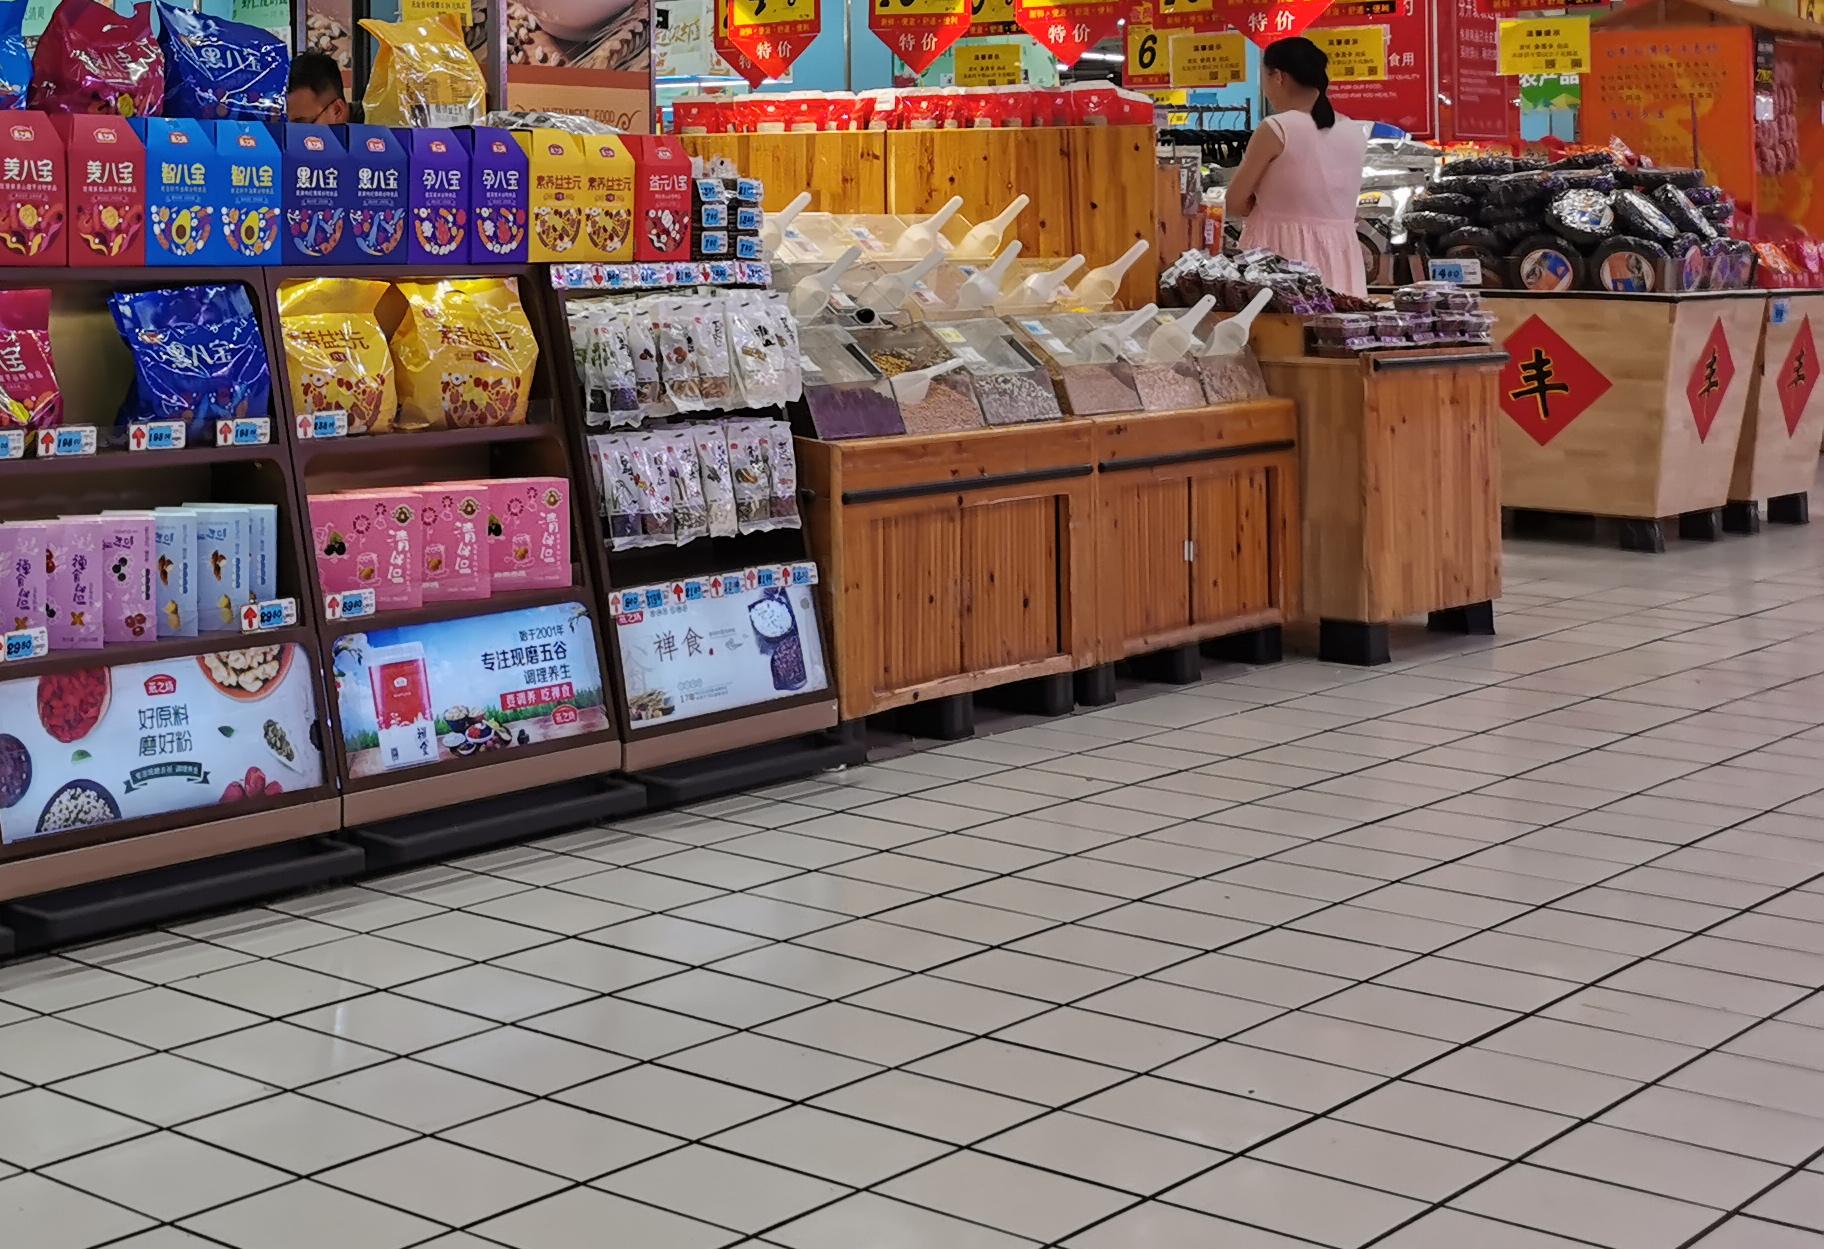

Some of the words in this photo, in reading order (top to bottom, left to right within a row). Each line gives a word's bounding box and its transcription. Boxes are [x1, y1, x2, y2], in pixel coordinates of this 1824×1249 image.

[1047, 23, 1091, 44] 特价
[1247, 11, 1295, 33] 特价
[756, 40, 792, 60] 特价
[898, 32, 938, 52] 特价
[2, 158, 54, 182] 美八宝
[86, 160, 134, 184] 美八宝
[161, 162, 207, 186] 智八宝
[231, 163, 274, 187] 智八宝
[296, 166, 338, 190] 黑八宝
[357, 167, 399, 190] 黑八宝
[422, 168, 462, 190] 孕八宝
[482, 168, 520, 190] 孕八宝
[535, 175, 582, 190] 素养益生元
[587, 176, 633, 193] 素养益生元
[648, 174, 688, 192] 益元八宝
[1508, 348, 1570, 420] 丰
[518, 624, 565, 642] 始于2001年
[653, 626, 705, 663] 禅食
[481, 640, 568, 671] 专注现磨五谷
[523, 663, 572, 685] 调理养生
[506, 692, 537, 709] 要调养
[541, 684, 571, 701] 吃禅食
[138, 703, 189, 731] 好原料
[138, 729, 193, 757] 磨好粉
